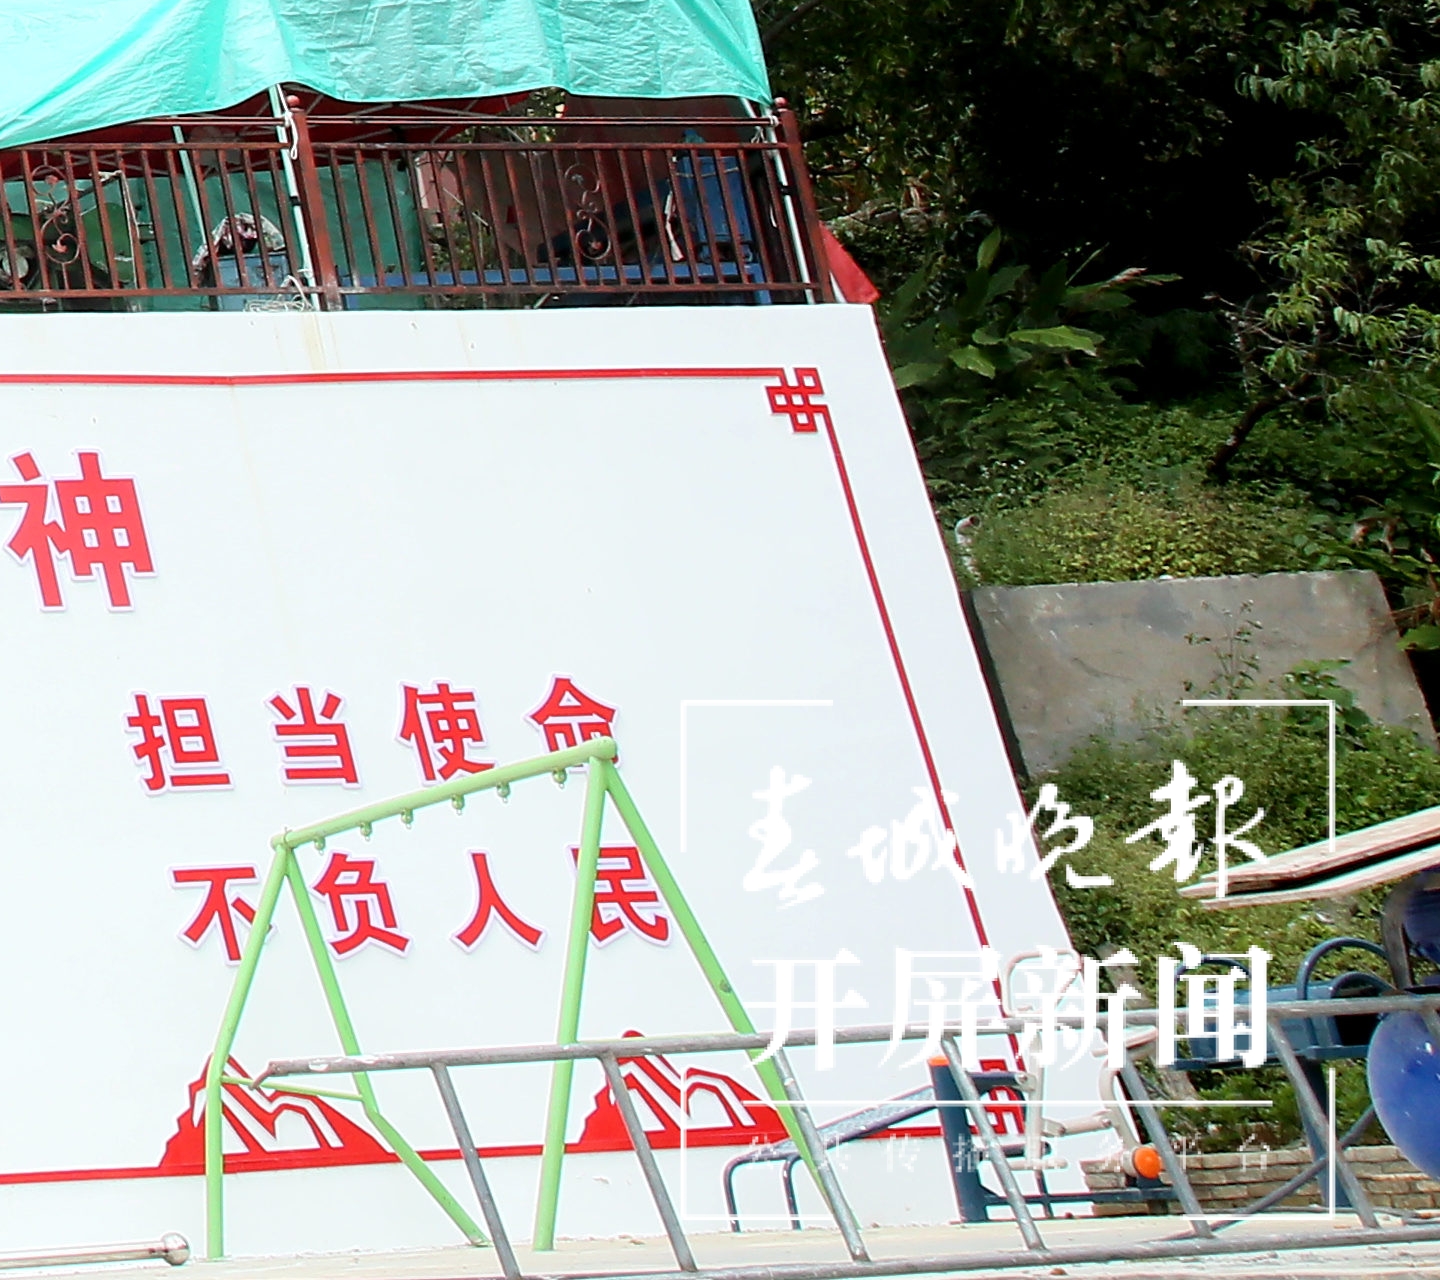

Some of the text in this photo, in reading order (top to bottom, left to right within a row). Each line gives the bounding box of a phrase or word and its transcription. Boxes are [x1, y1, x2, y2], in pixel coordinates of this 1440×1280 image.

[126, 676, 618, 792] 担当使命
[171, 845, 670, 962] 不负人民
